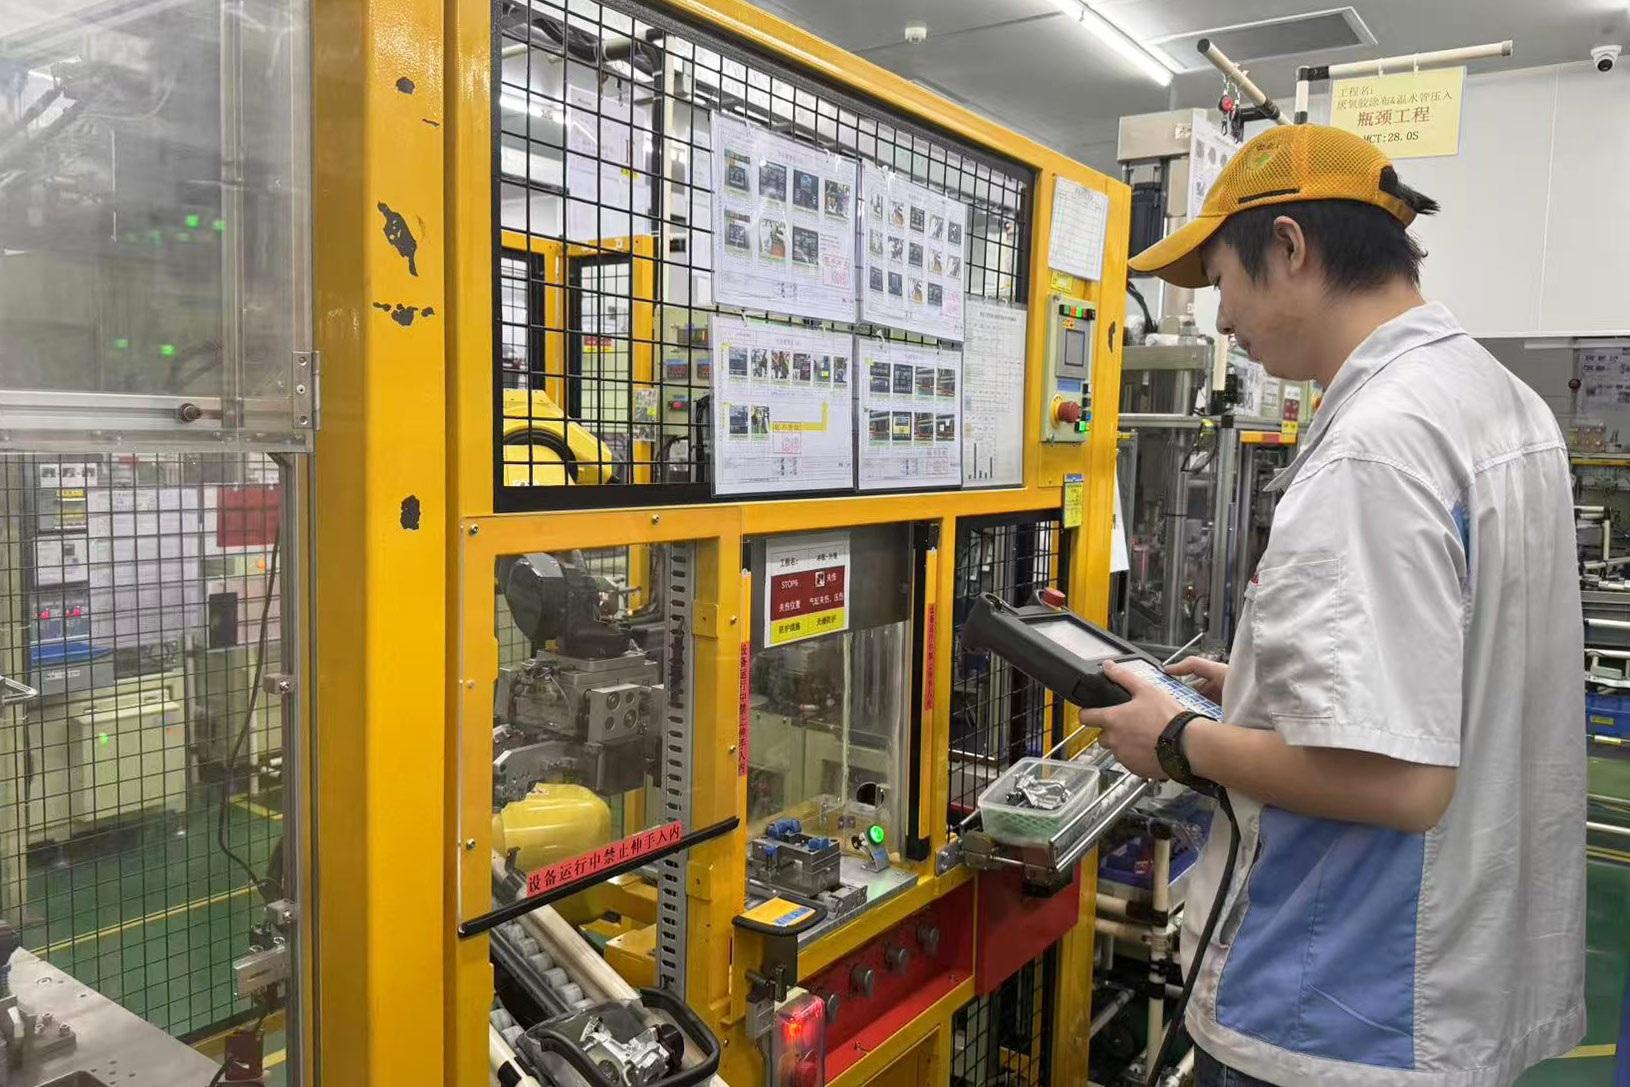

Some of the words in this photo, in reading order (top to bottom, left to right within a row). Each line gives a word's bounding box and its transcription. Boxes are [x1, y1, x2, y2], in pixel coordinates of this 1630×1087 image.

[1357, 106, 1430, 127] 瓶颈工程
[528, 826, 681, 892] 设备运行中禁止伸手入内
